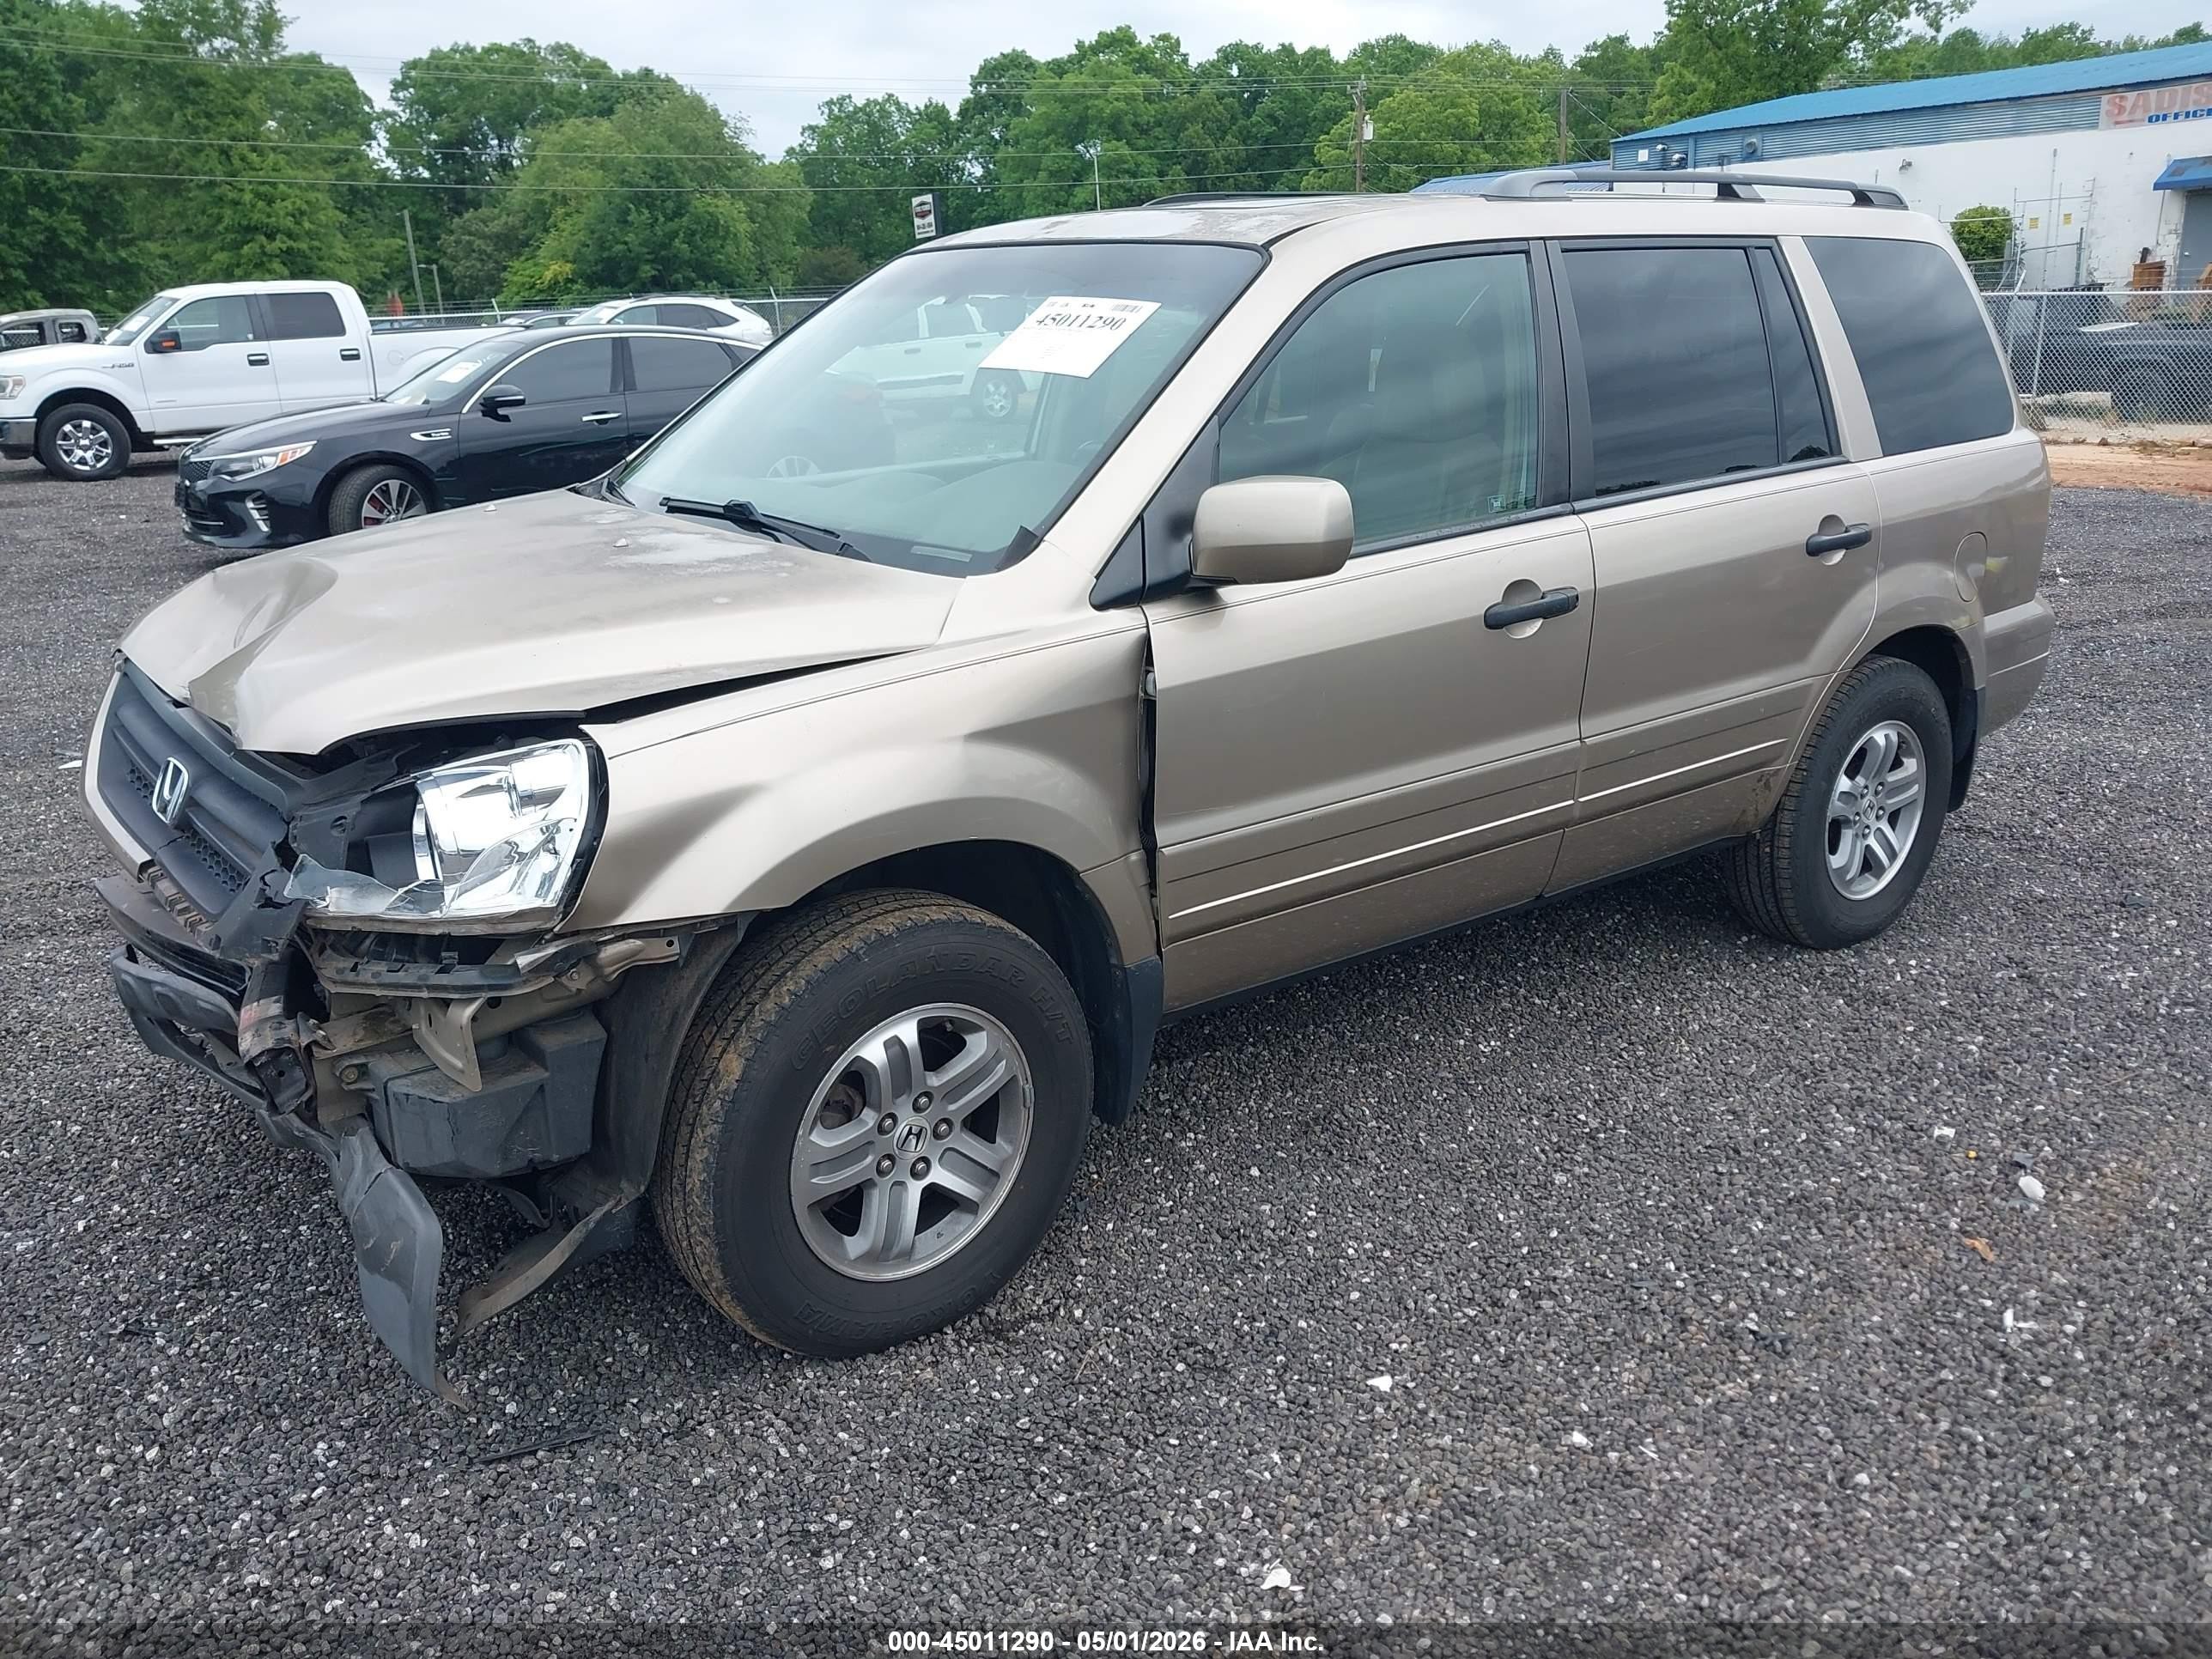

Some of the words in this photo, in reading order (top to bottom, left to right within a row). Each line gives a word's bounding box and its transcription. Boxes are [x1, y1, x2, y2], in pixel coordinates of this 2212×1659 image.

[1036, 313, 1127, 331] 45011290
[791, 951, 1027, 1071] GEOLANDAR
[1030, 987, 1074, 1046] H/T
